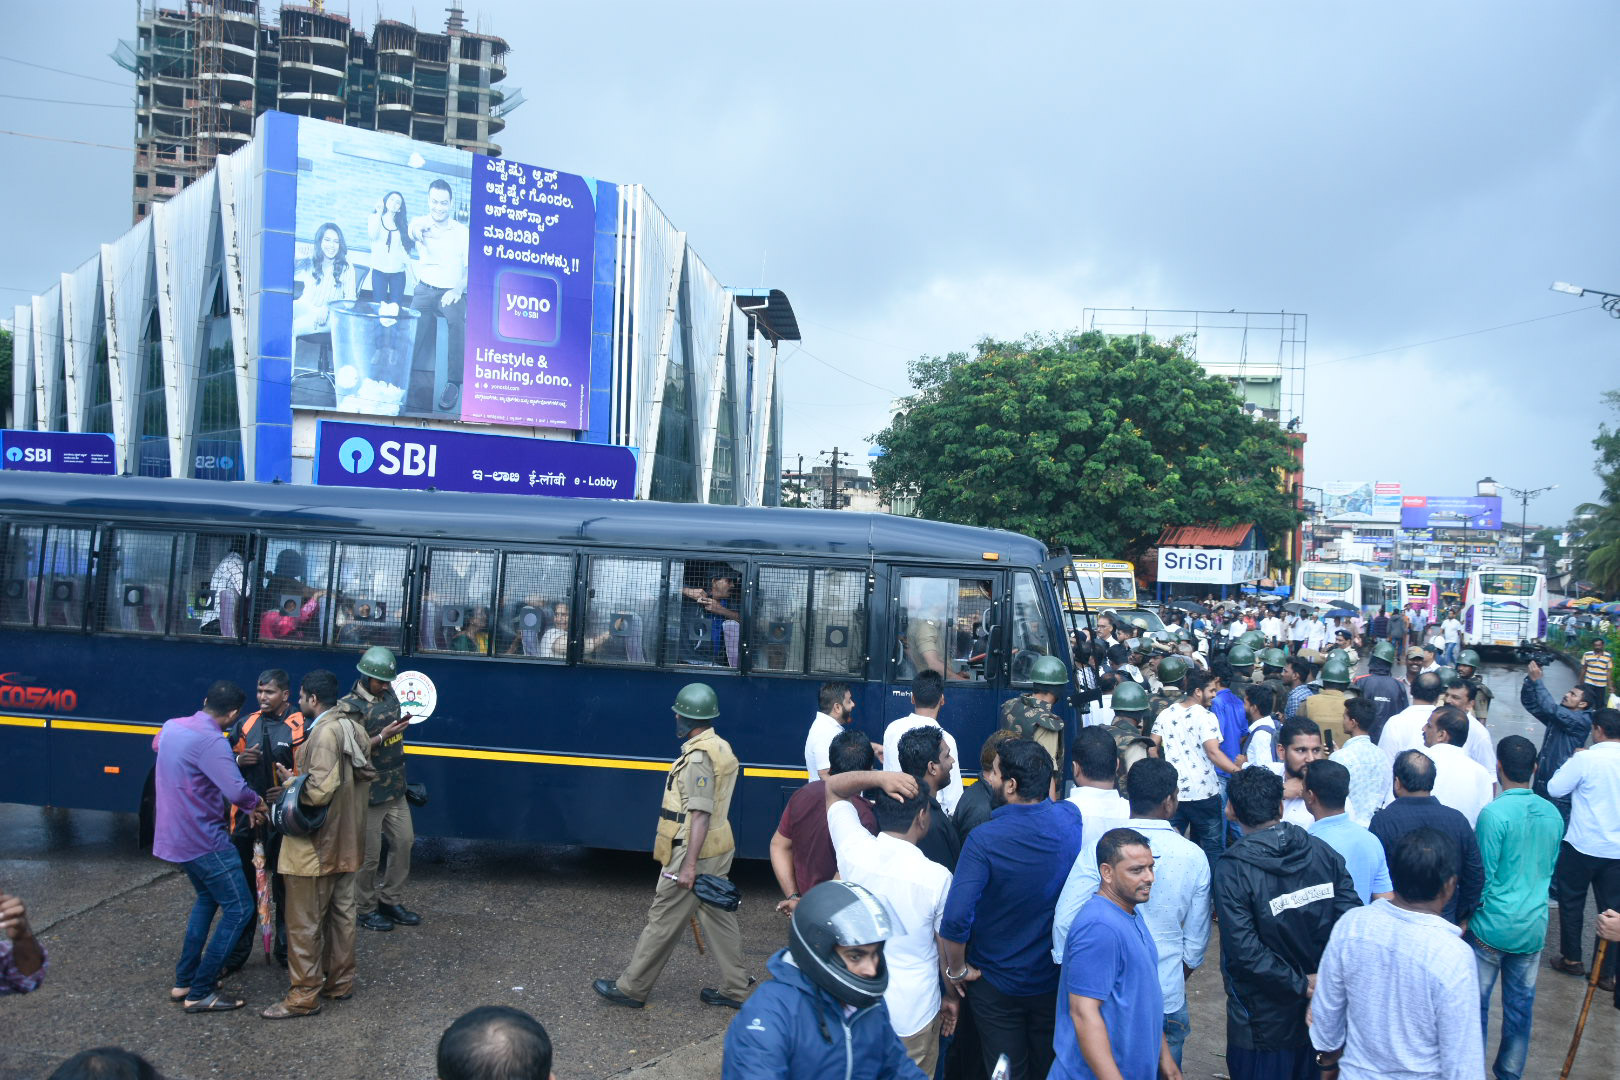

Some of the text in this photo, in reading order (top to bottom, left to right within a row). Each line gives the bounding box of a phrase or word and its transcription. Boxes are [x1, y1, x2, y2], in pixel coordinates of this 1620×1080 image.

[506, 293, 551, 313] yono
[514, 309, 539, 319] by SBI
[475, 347, 549, 369] Lifestyle &
[475, 364, 573, 388] banking, dono.
[24, 447, 52, 463] SBI
[378, 440, 437, 478] SBI
[588, 475, 618, 490] Lobby
